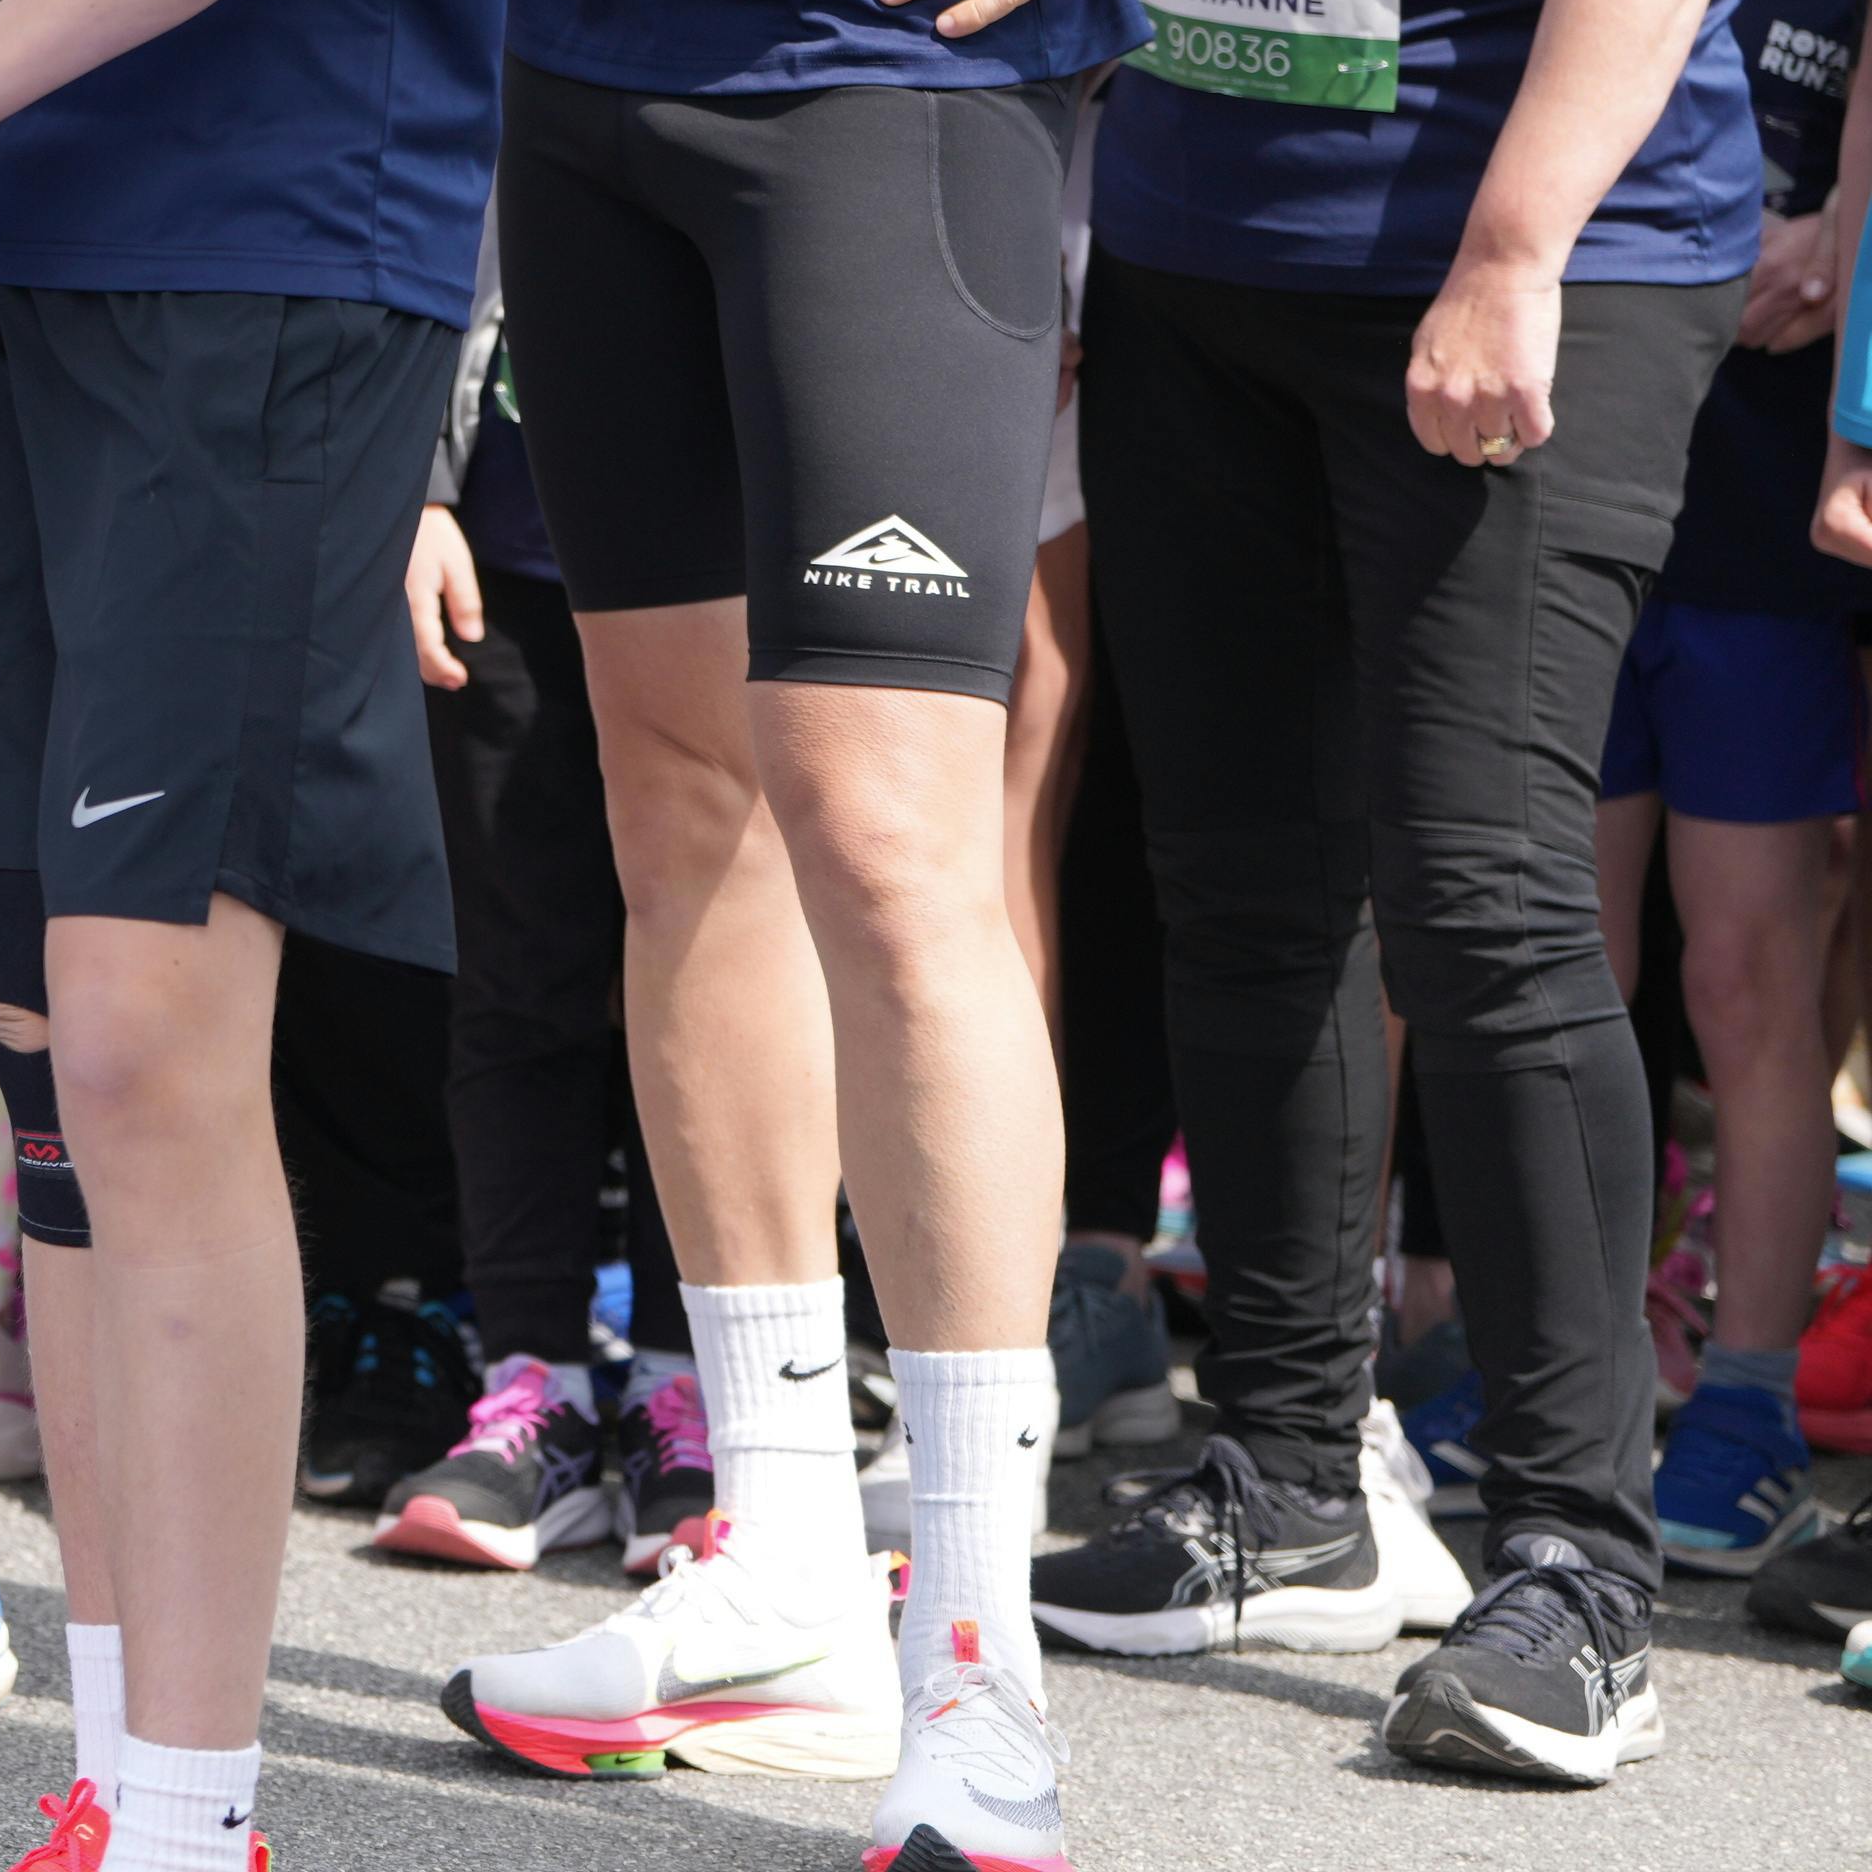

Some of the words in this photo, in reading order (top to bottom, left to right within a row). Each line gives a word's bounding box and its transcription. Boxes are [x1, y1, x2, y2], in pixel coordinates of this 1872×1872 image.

[1167, 22, 1291, 77] 90836
[803, 568, 873, 589] NIKE
[886, 576, 970, 598] TRAIL
